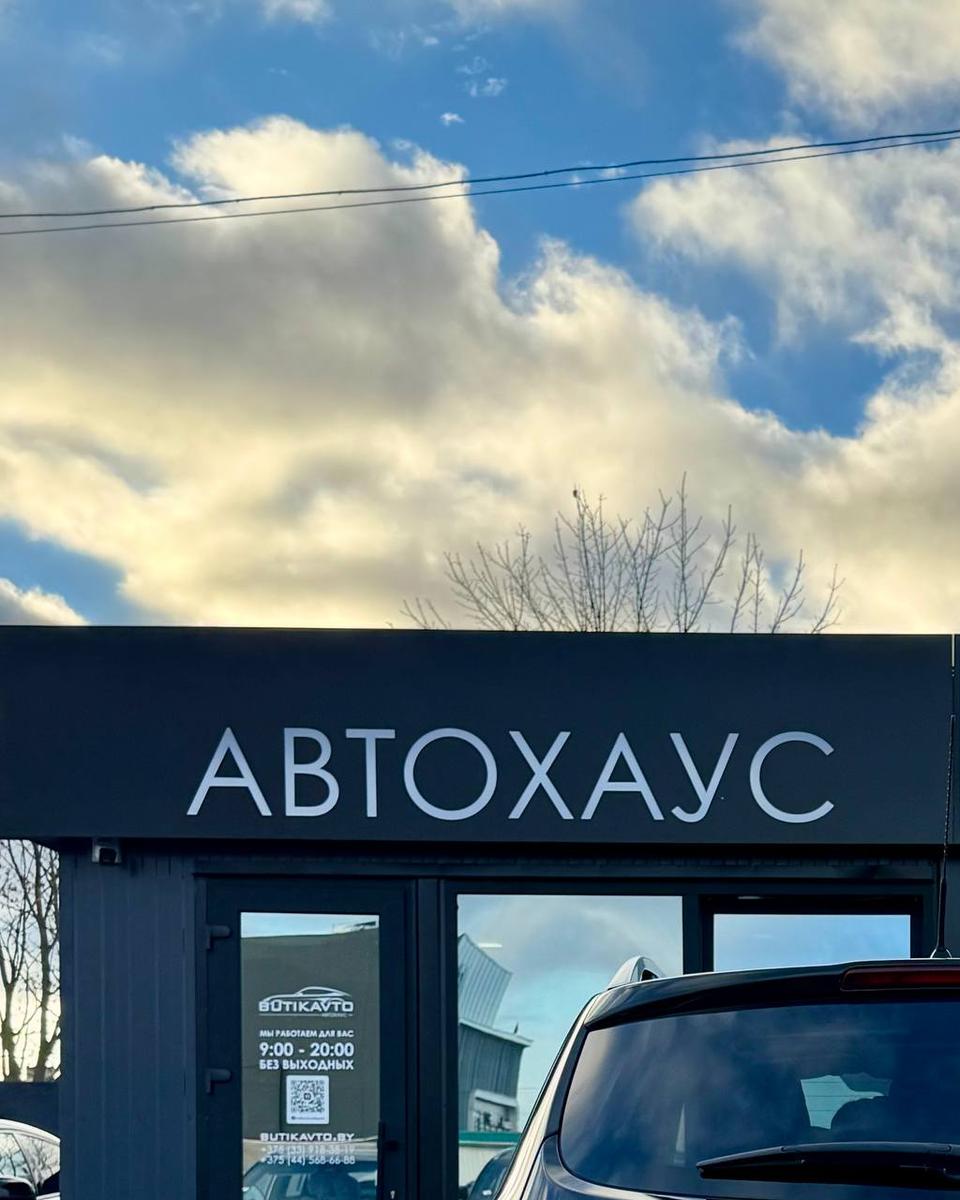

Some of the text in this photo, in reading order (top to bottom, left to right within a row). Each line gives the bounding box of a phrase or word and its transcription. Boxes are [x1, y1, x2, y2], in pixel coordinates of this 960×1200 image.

[186, 727, 835, 823] АВТОХАУС
[258, 1000, 354, 1012] BUTIKAVTO
[259, 1042, 294, 1056] 9:00
[310, 1042, 354, 1056] 20:00
[259, 1060, 354, 1070] БЕЗ ВЫХОДНЫХ
[260, 1133, 354, 1141] BUTIKAVTO.BY
[261, 1155, 356, 1166] +375 (44) 568-66-88
